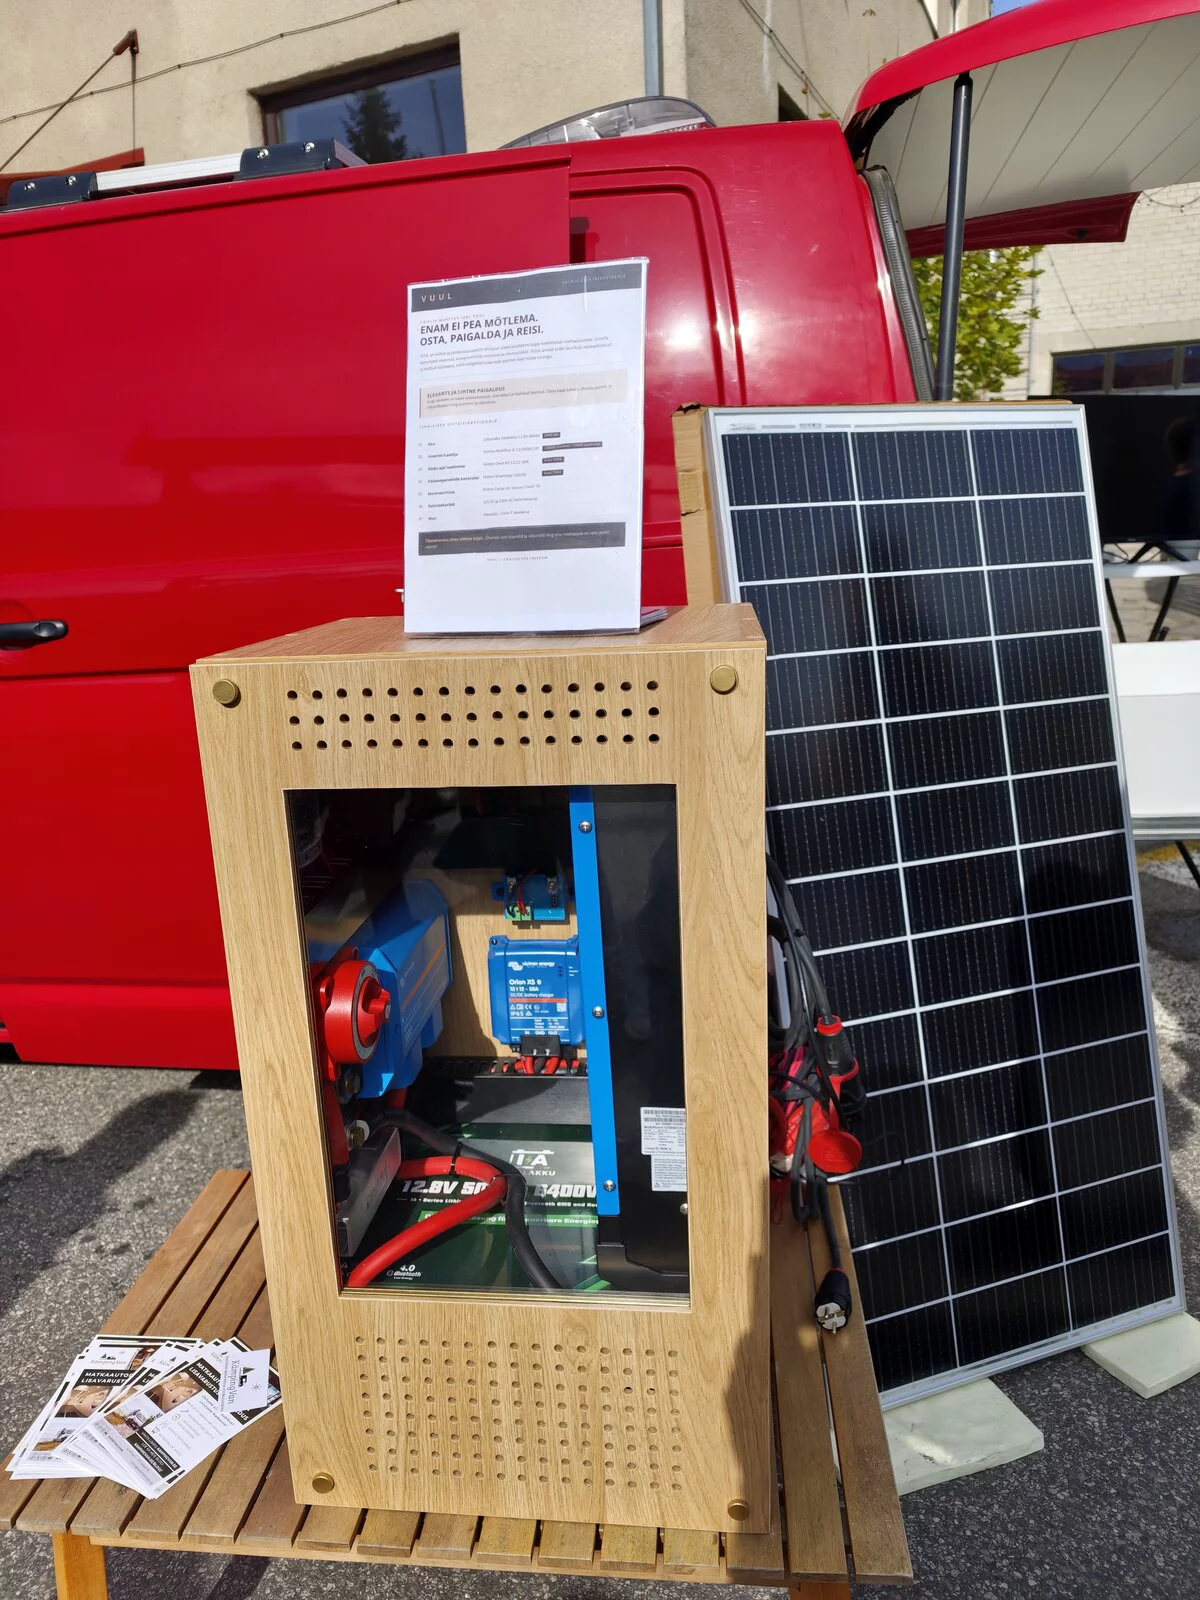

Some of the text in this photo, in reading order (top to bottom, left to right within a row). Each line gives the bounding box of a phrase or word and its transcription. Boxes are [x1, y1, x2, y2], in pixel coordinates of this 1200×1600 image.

[421, 292, 452, 303] VUUL
[420, 323, 449, 335] ENAM
[452, 322, 460, 331] EI
[463, 320, 482, 330] PEA
[484, 314, 538, 328] MÕTLEMA.
[420, 325, 544, 347] OSTA, PAIGALDA JA REISI.
[402, 1180, 459, 1195] 12.8V
[400, 1264, 416, 1272] 4.0
[196, 1362, 220, 1384] MATKAAUT
